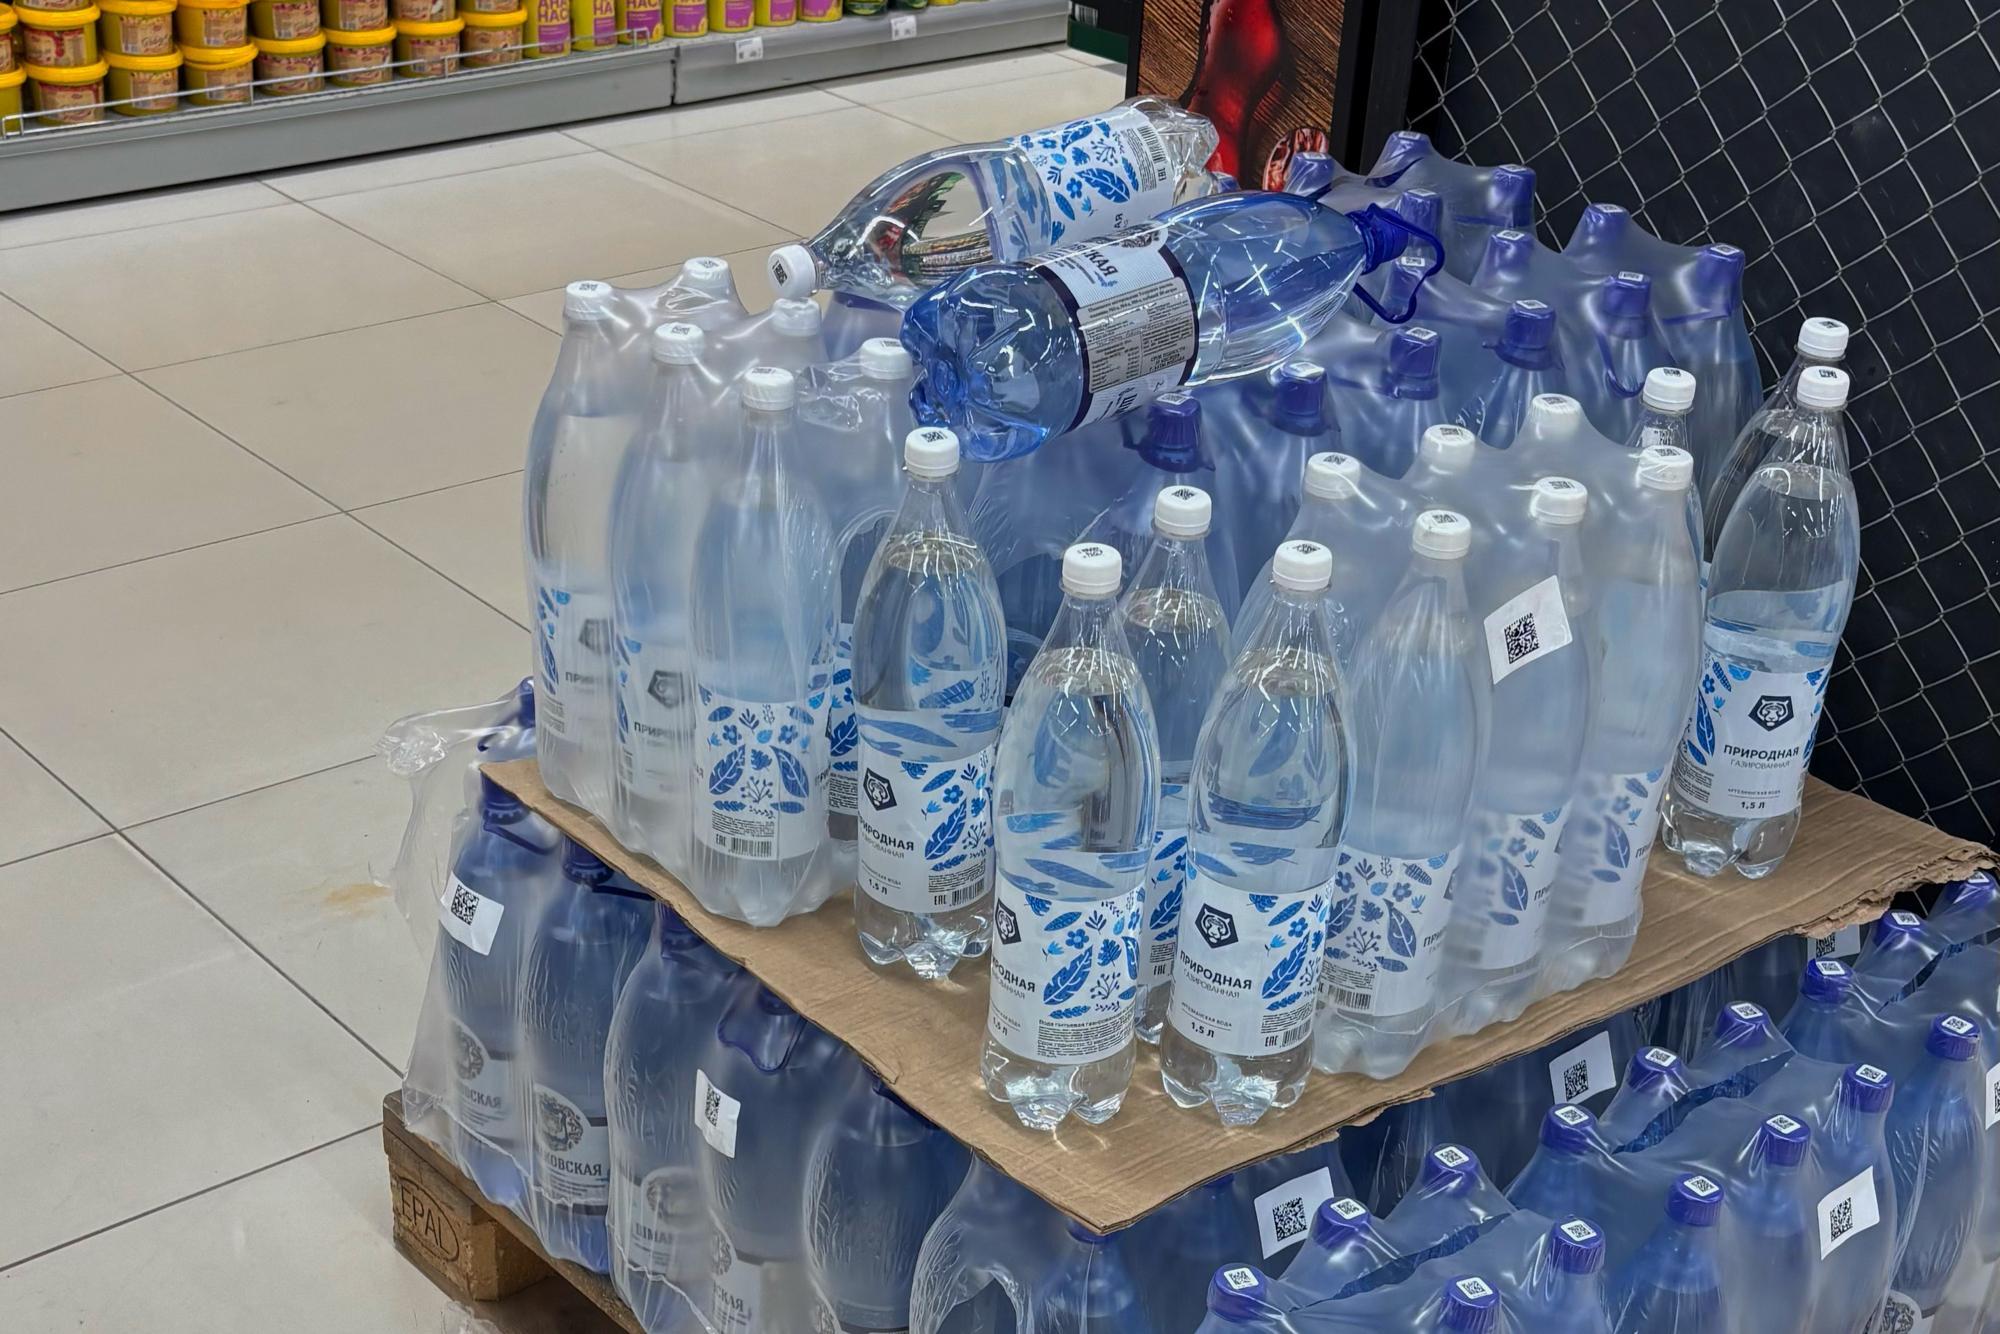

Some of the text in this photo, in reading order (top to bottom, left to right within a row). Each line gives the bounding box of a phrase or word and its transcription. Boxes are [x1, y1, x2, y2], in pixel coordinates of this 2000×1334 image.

[1723, 744, 1800, 761] ПРИРОДНАЯ
[1730, 759, 1790, 770] ГАЗИРОВАННАЯ
[1180, 950, 1252, 990] ПРИРОДНАЯ
[401, 1183, 451, 1256] EPAL
